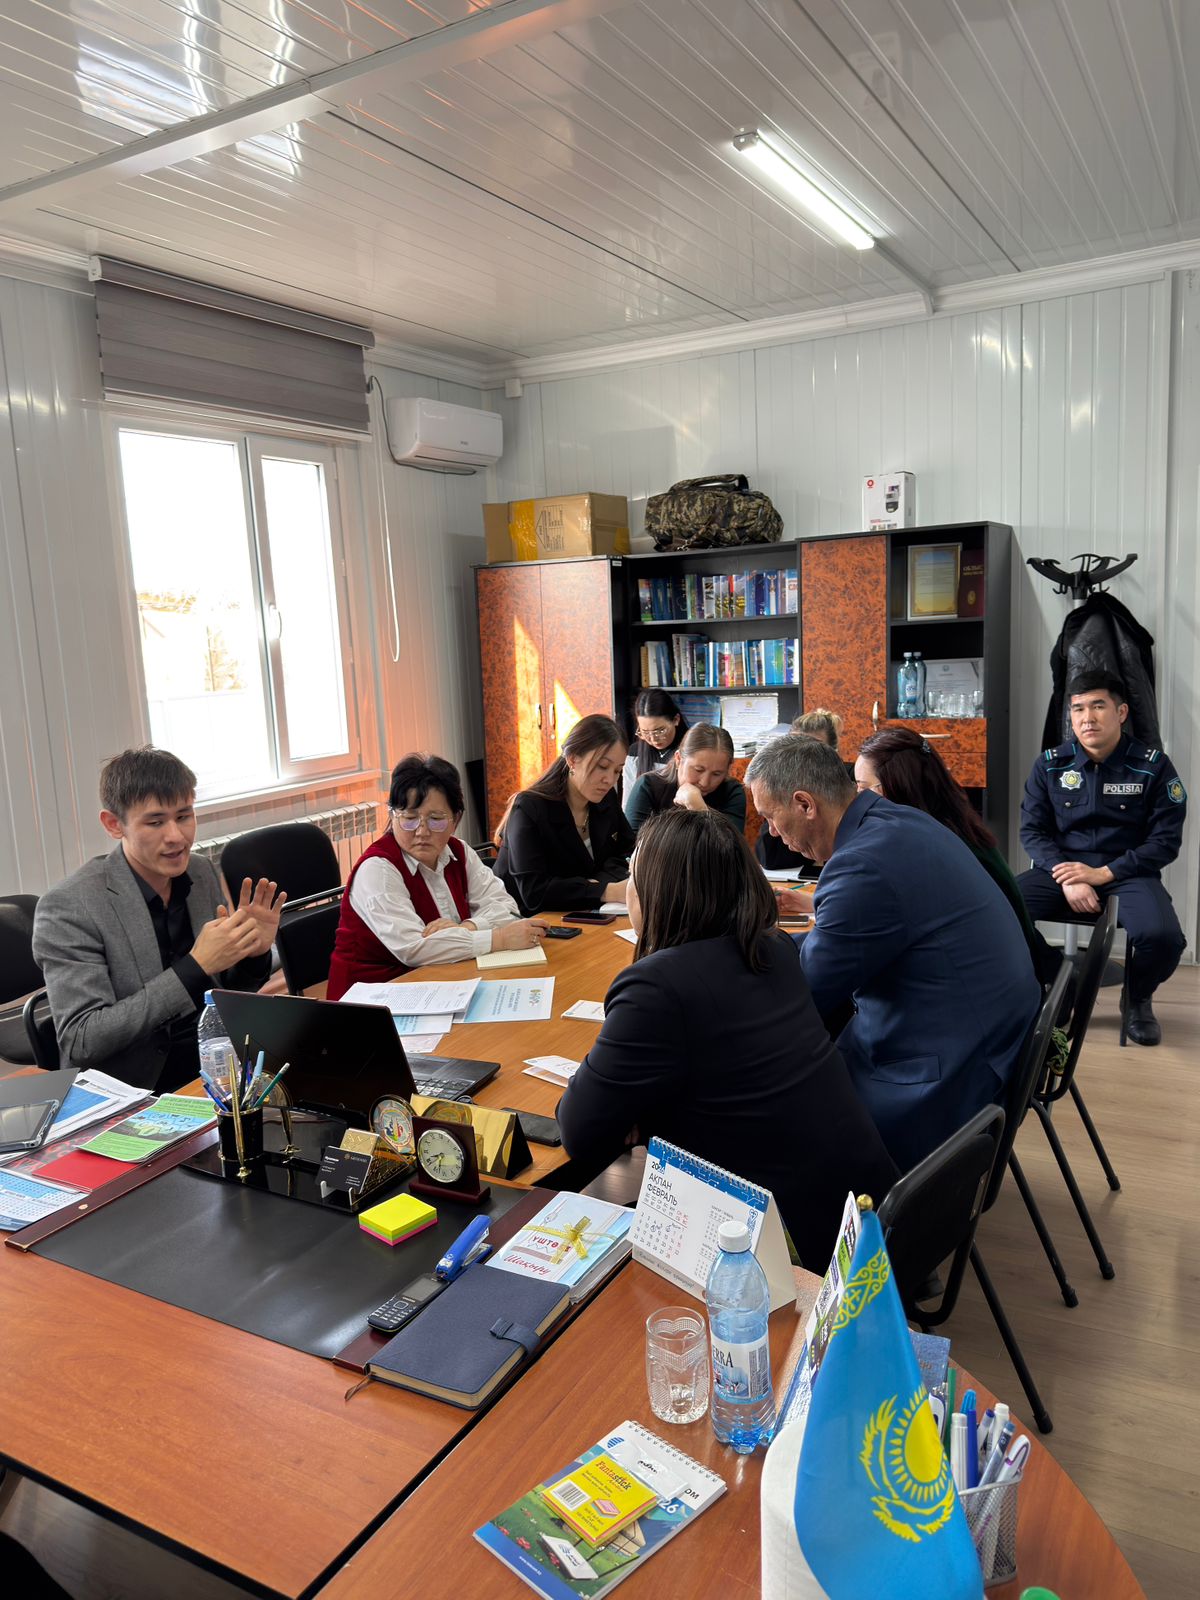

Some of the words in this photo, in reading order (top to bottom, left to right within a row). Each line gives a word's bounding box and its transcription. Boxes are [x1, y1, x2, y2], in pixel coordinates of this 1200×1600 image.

[1105, 784, 1141, 793] POLISIA
[647, 1184, 677, 1206] ФЕВРАЛЬ
[712, 1345, 733, 1368] ERRA
[595, 1460, 632, 1491] Fantastick
